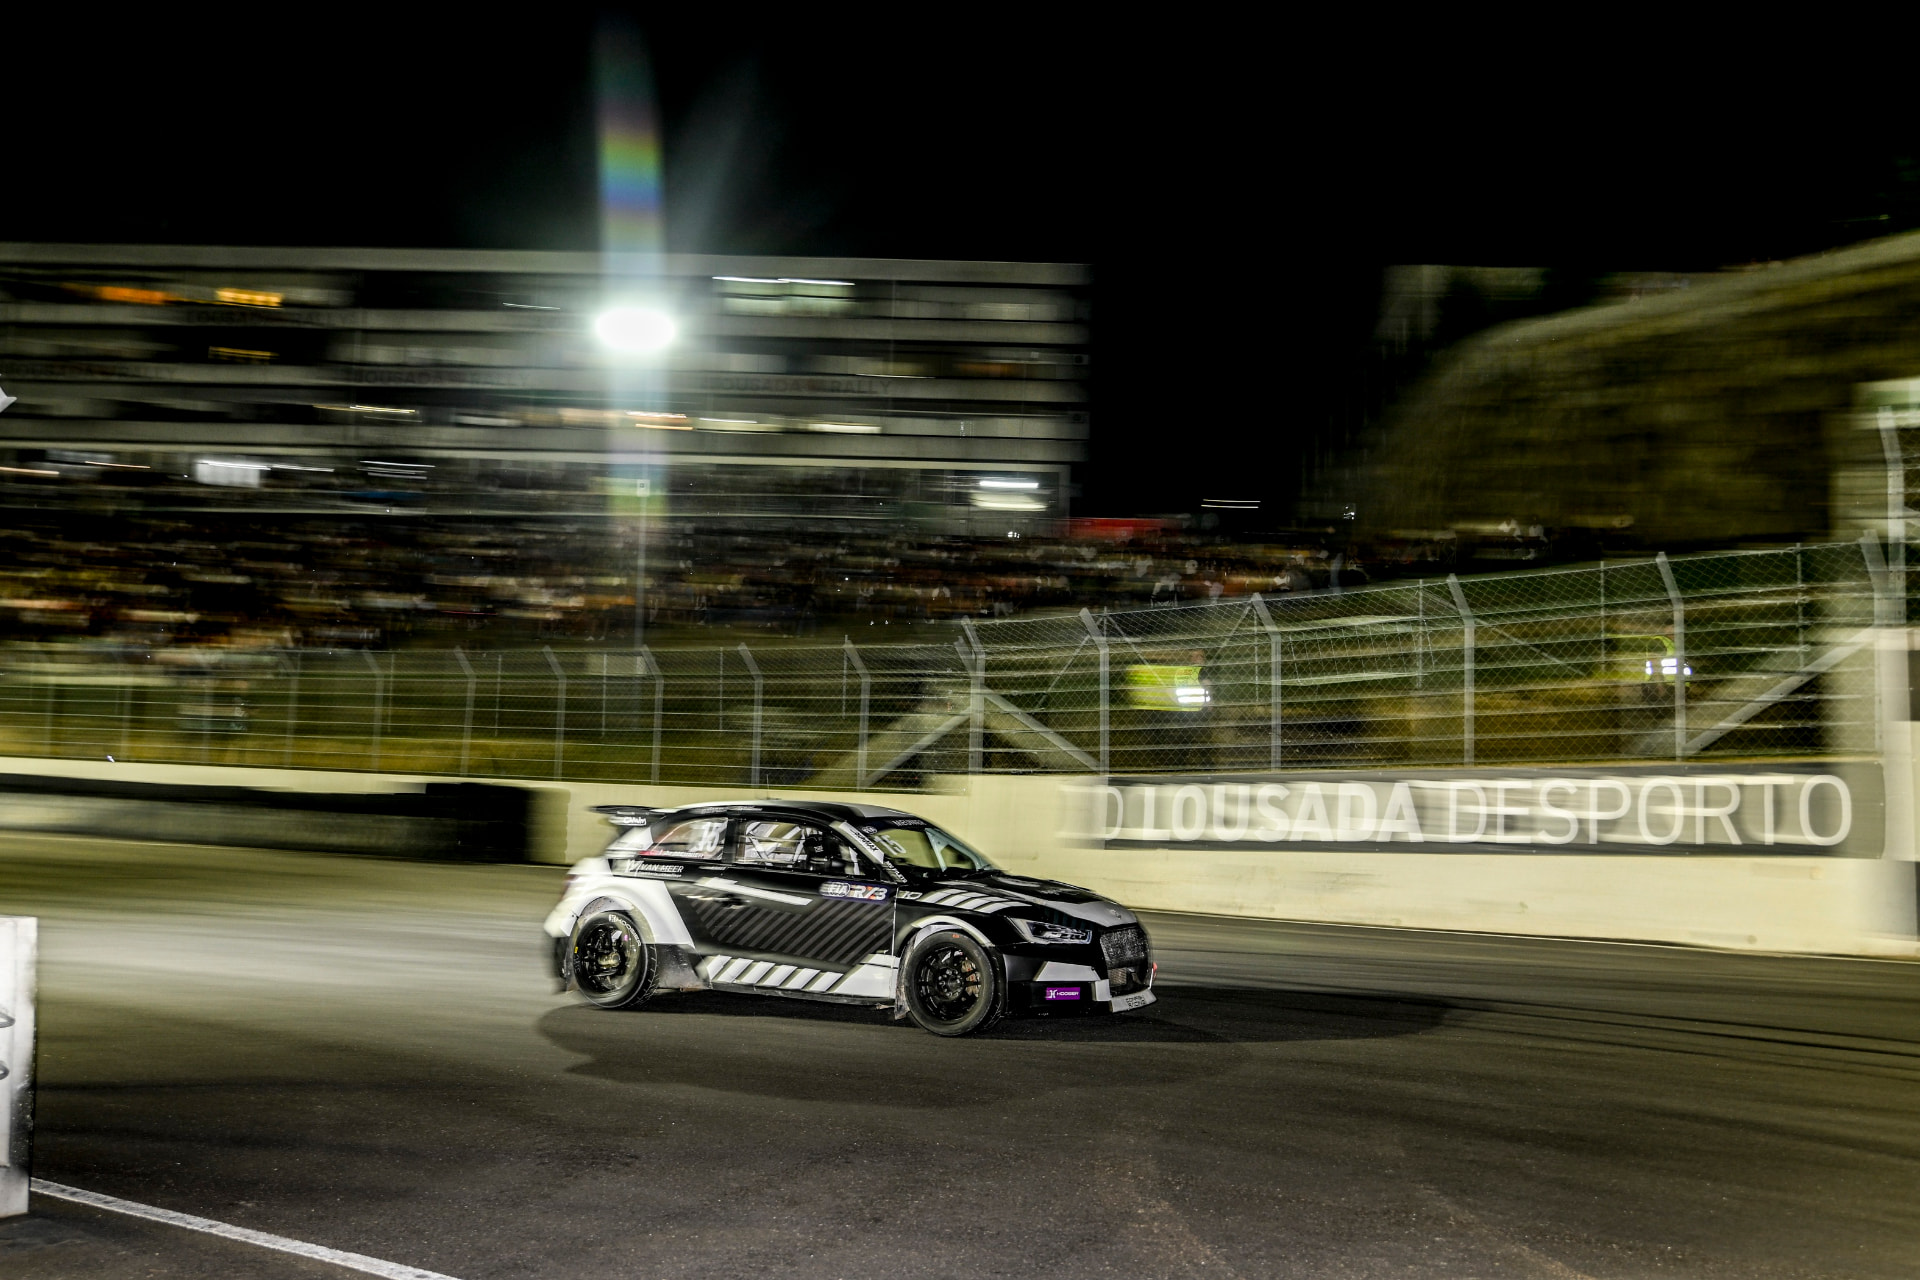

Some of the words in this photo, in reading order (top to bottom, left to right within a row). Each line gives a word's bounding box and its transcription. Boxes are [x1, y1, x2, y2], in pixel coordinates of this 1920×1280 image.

[1143, 782, 1425, 842] LOUSADA
[1449, 774, 1852, 845] DESPORTO
[873, 834, 907, 855] 15
